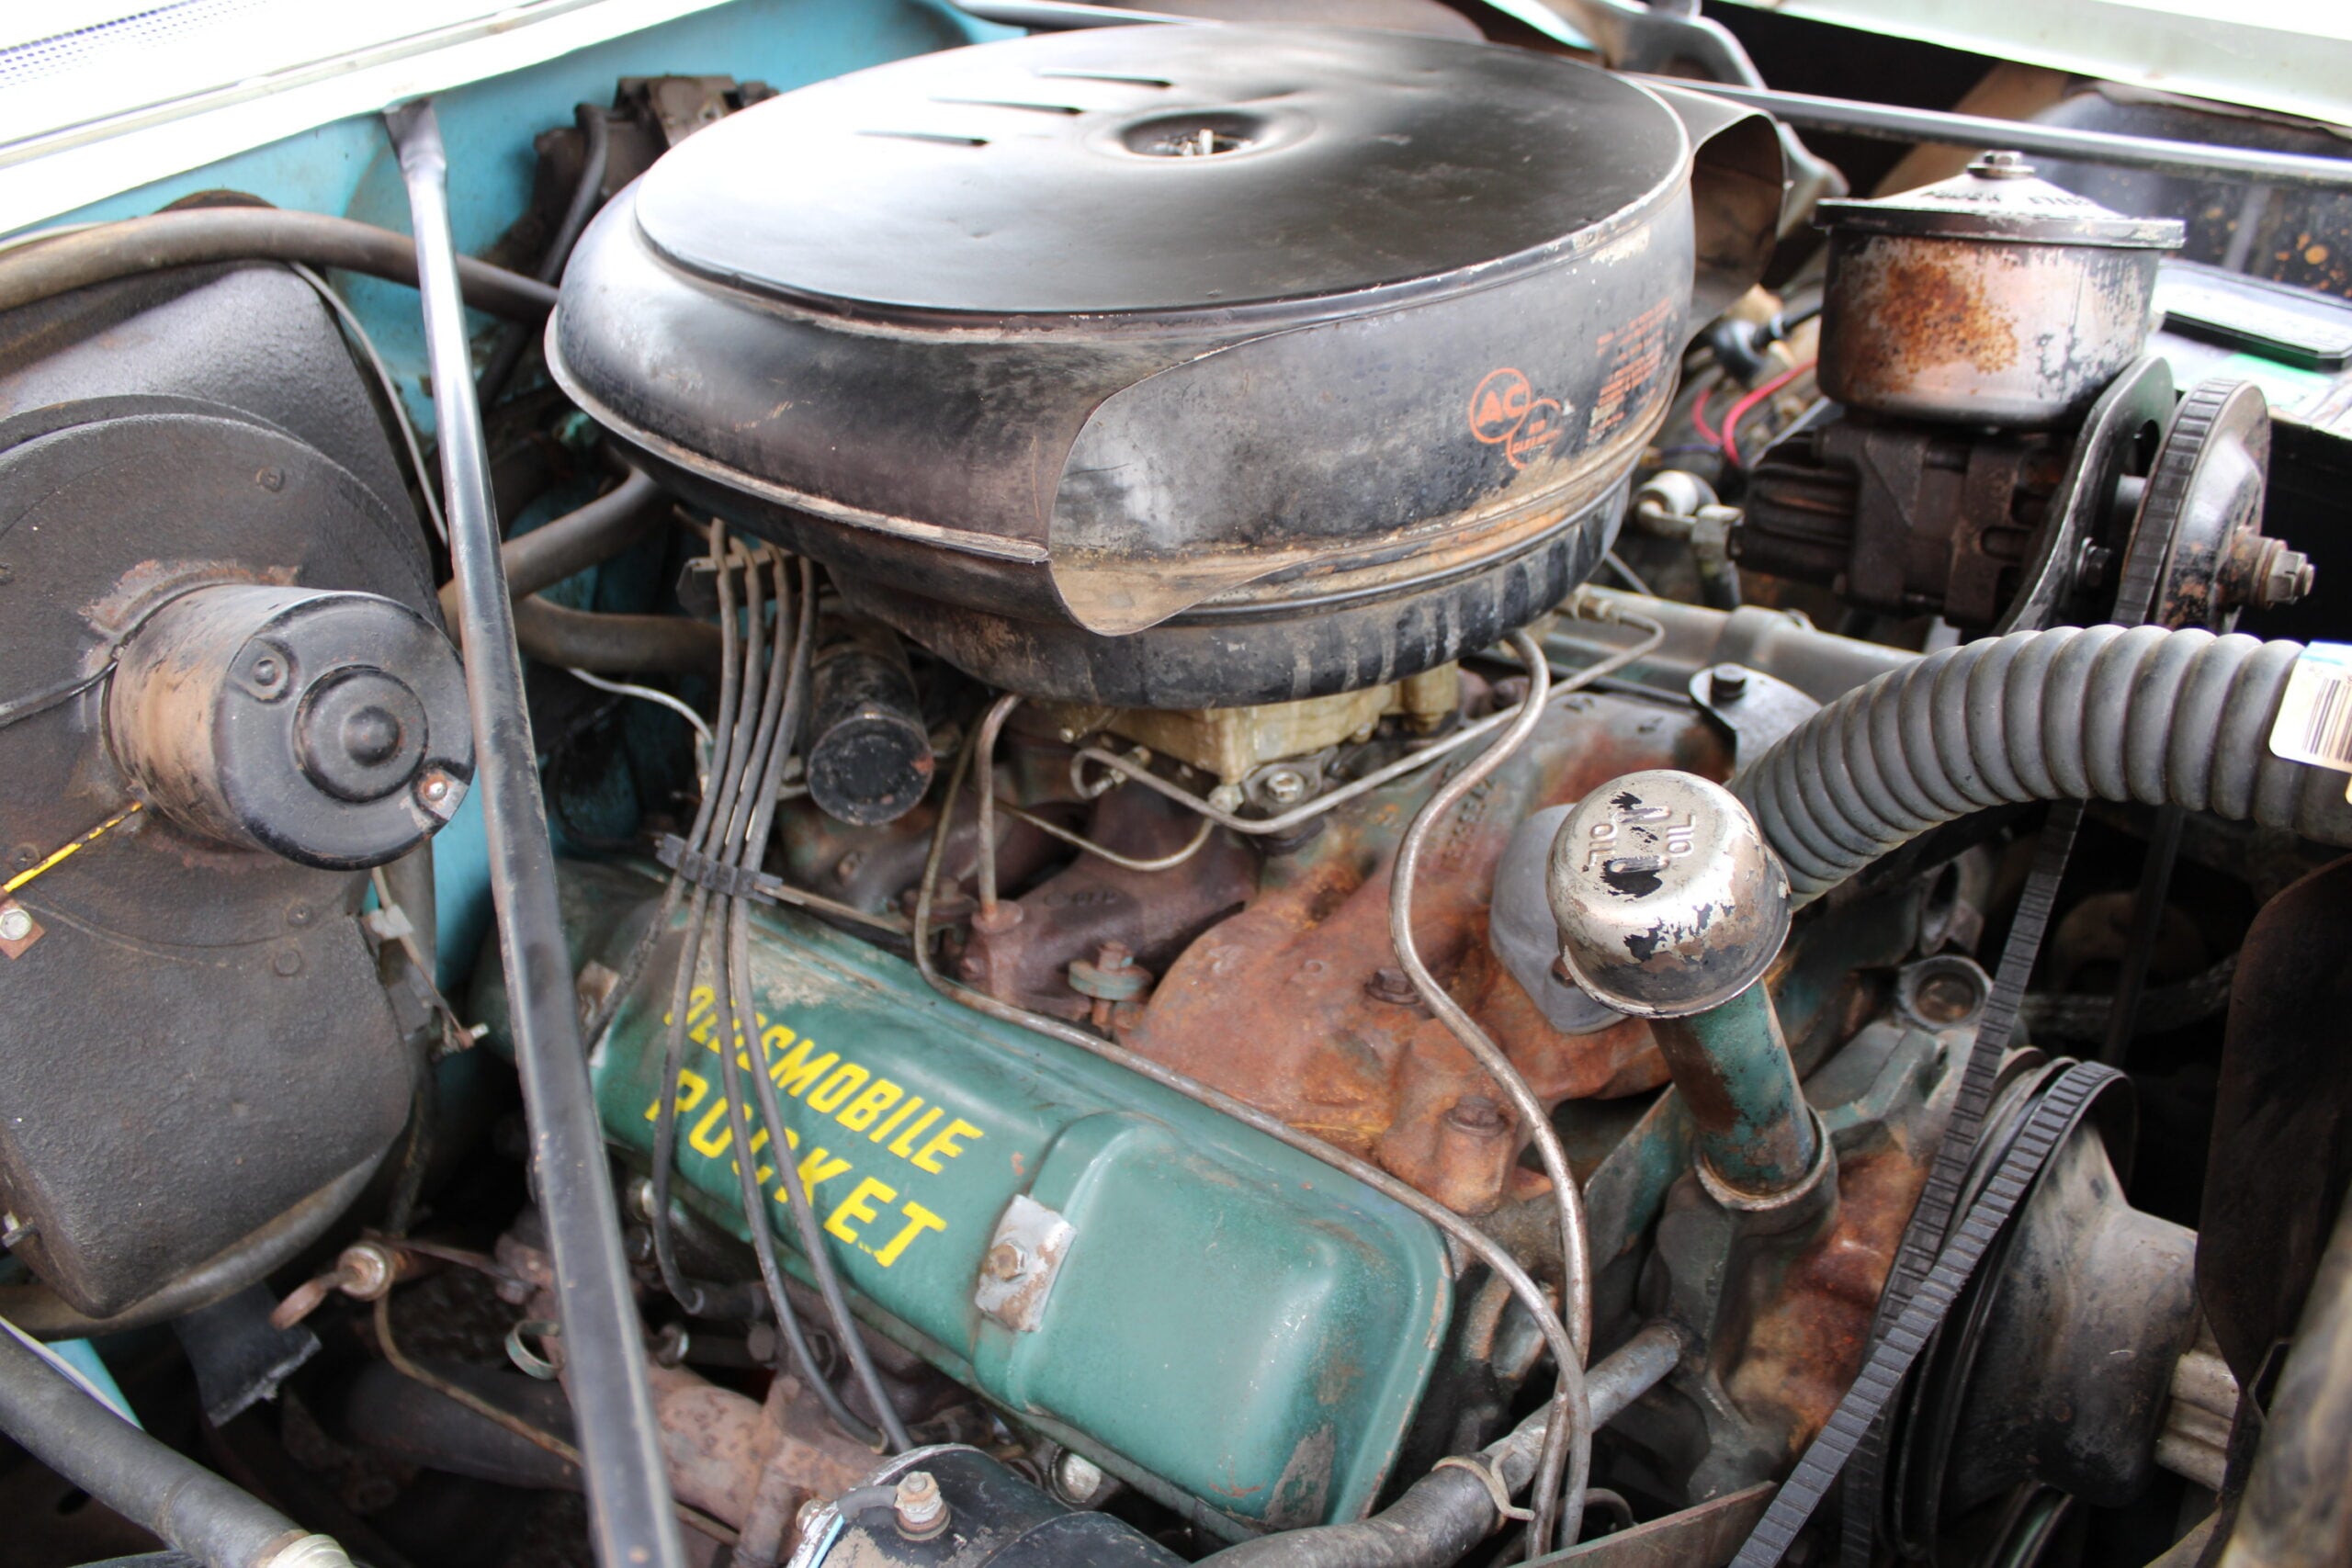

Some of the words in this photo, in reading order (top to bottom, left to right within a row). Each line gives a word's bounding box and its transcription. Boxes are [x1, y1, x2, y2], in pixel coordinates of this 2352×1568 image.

[1477, 383, 1527, 426] AC
[1589, 823, 1618, 866] OIL
[1666, 814, 1696, 857] OIL
[663, 986, 985, 1174] OLSMOBILE
